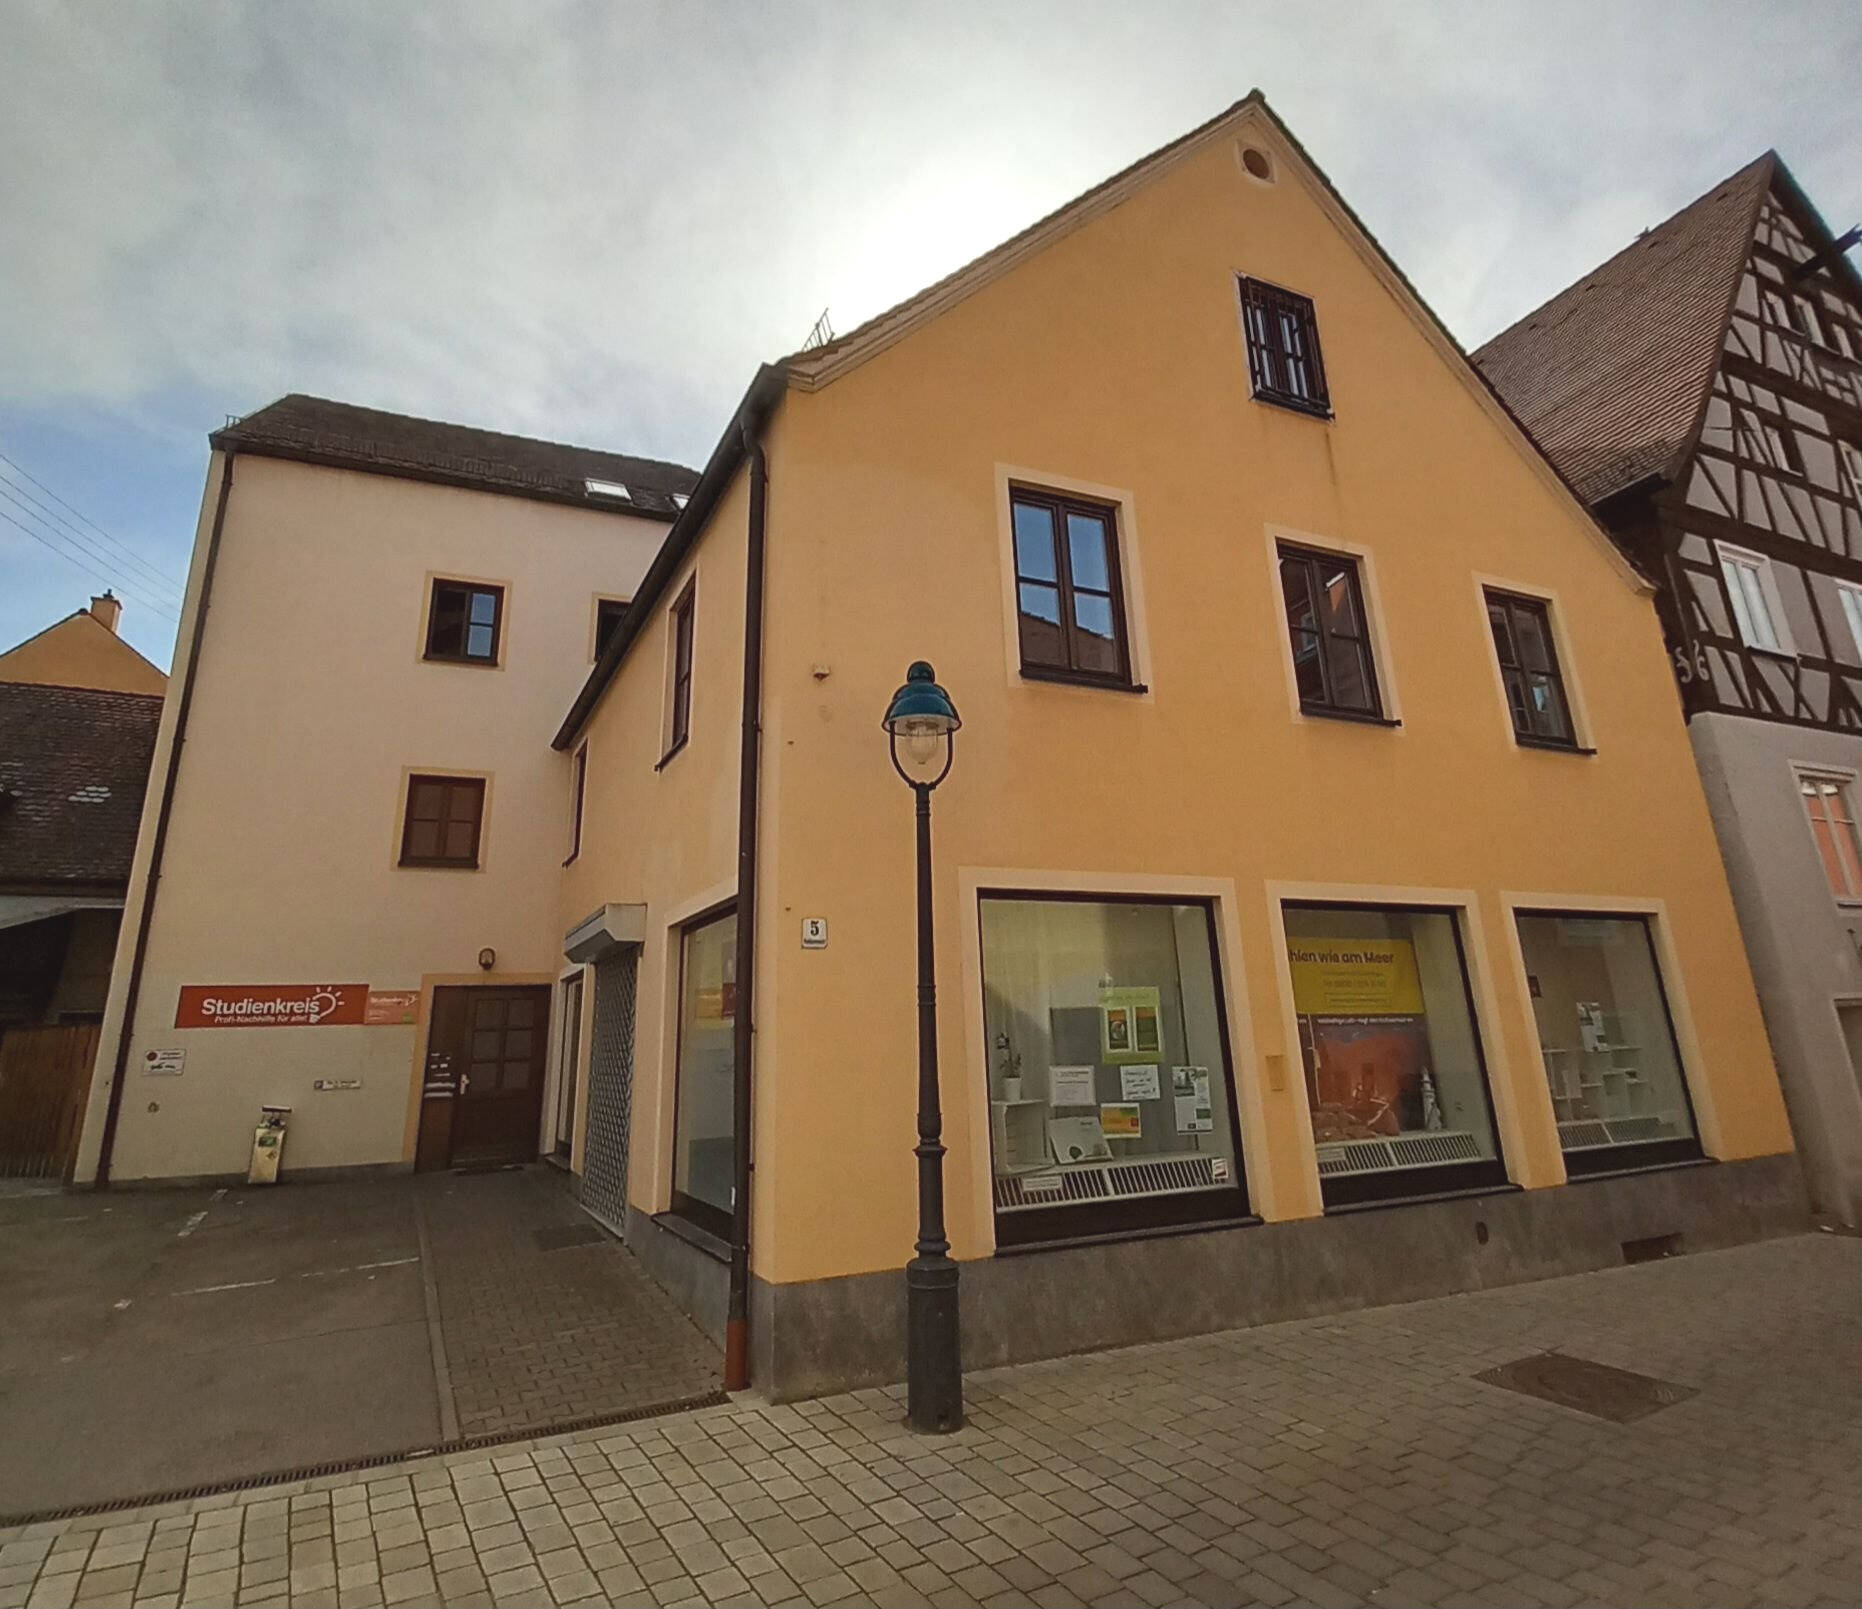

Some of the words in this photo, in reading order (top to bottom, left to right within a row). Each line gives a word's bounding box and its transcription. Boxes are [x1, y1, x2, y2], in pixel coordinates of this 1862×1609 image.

[810, 920, 820, 937] 5
[1318, 950, 1340, 964] wie
[1341, 952, 1363, 963] am
[1364, 952, 1394, 964] Meer
[201, 997, 320, 1016] Studienkreis
